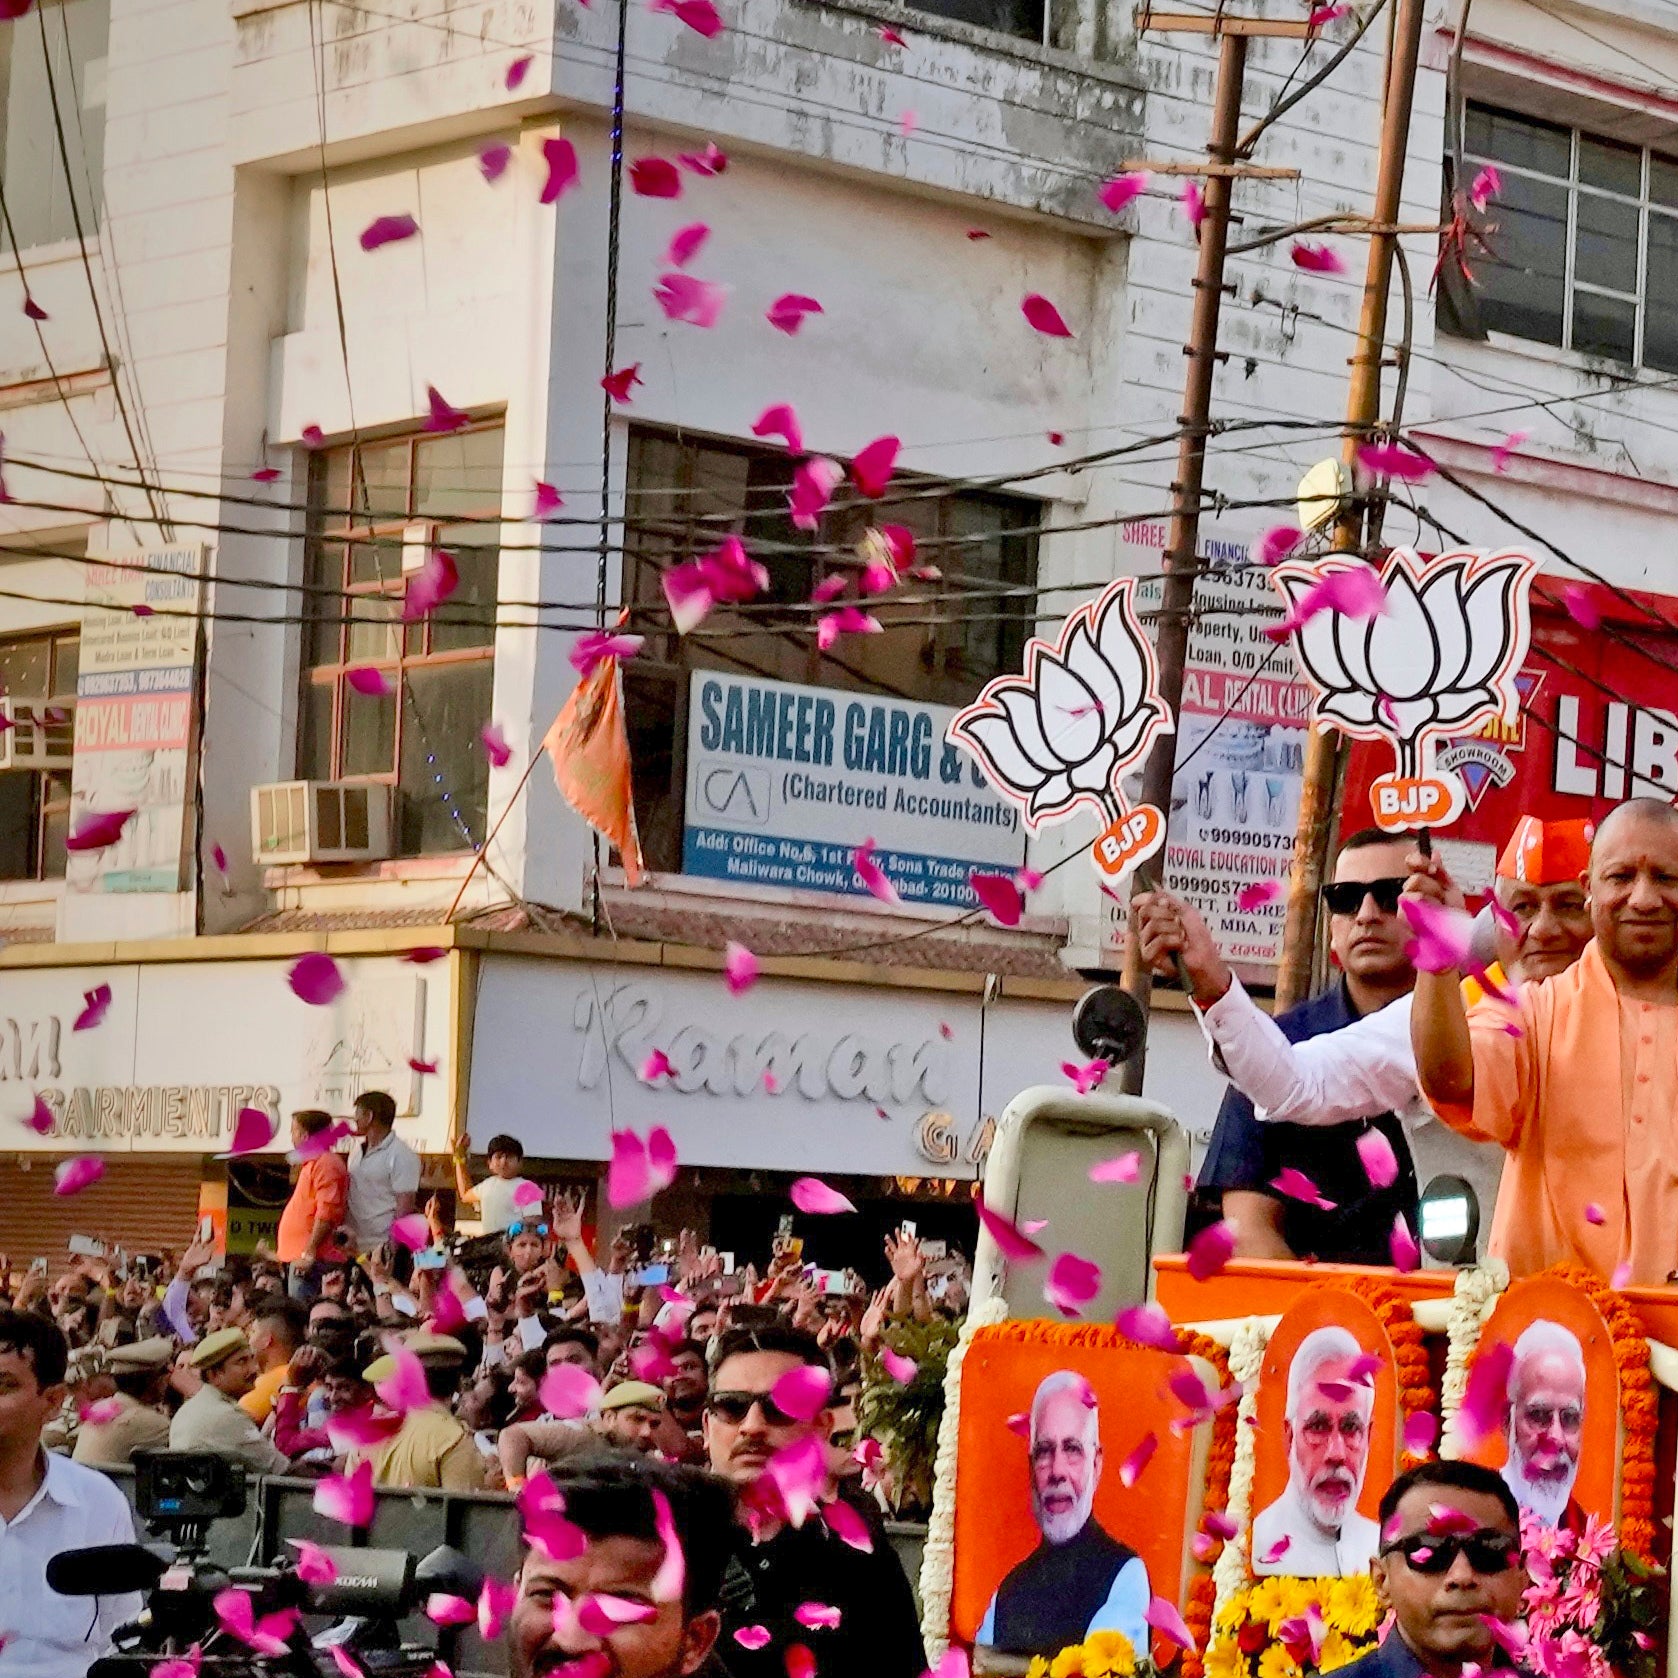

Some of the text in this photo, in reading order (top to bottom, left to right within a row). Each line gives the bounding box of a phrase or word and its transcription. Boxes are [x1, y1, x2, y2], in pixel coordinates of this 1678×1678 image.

[1122, 522, 1250, 562] SHREE FINANCI
[1188, 643, 1227, 666] Loan,
[1224, 678, 1274, 716] DENTAL
[76, 703, 129, 748] ROYAL
[700, 680, 963, 785] SAMEER GARG &
[1443, 747, 1508, 776] SHOWROOM
[782, 771, 888, 812] (Chartered
[894, 787, 1019, 834] Accountants)
[1380, 785, 1441, 815] BJP
[1100, 815, 1148, 863] BJP
[727, 855, 793, 881] Maliwara
[796, 866, 849, 891] Chowk,
[1167, 845, 1206, 870] ROYAL
[1209, 849, 1277, 876] EDUCATION
[572, 982, 949, 1107] Raman
[35, 1083, 282, 1139] GARMENTS
